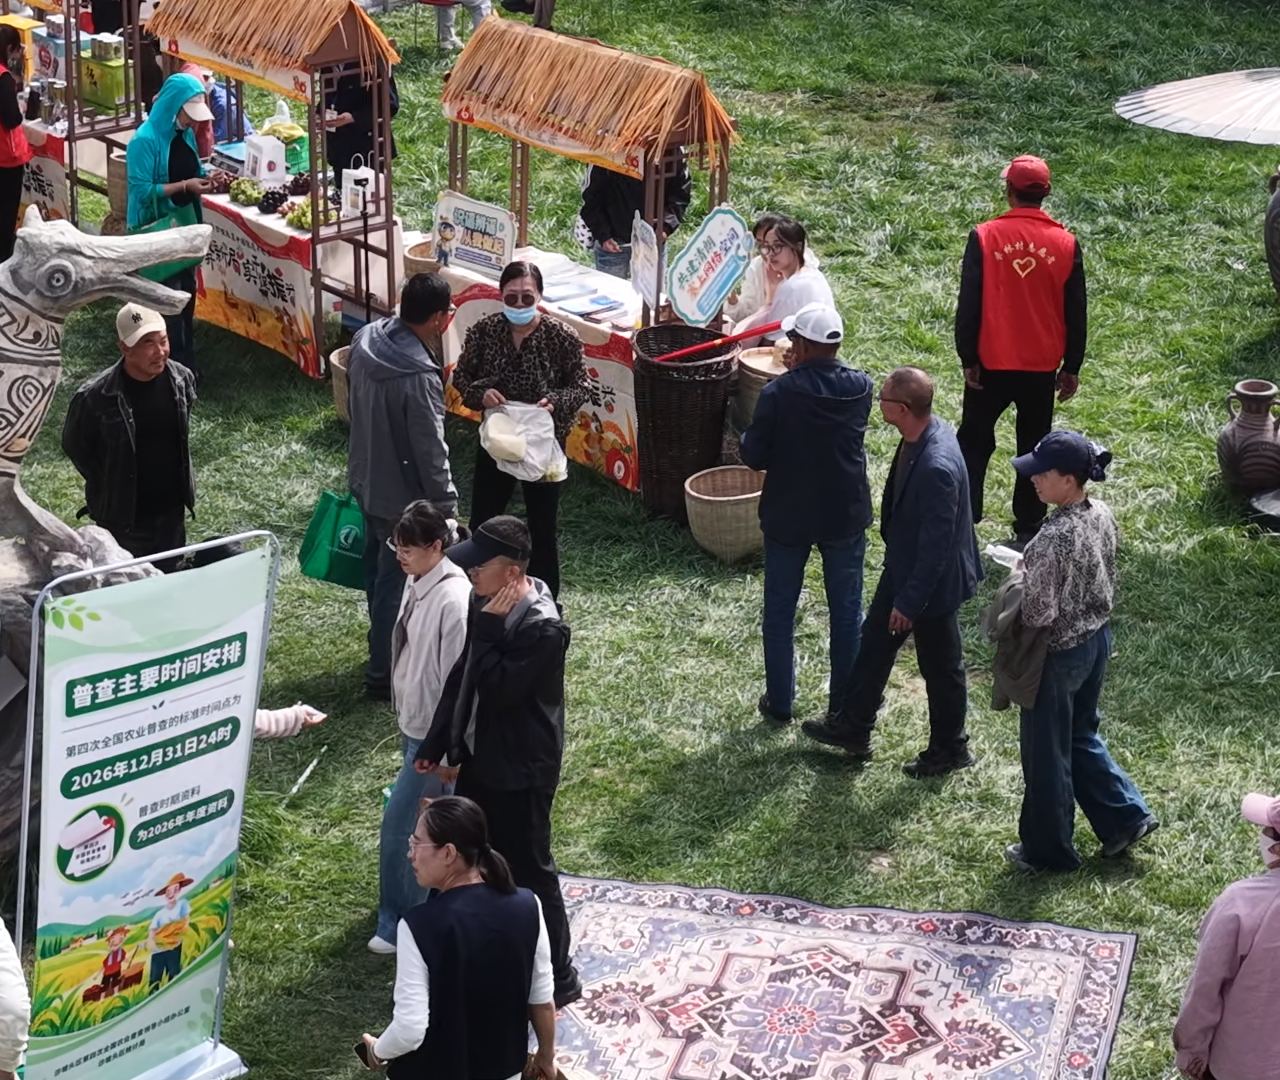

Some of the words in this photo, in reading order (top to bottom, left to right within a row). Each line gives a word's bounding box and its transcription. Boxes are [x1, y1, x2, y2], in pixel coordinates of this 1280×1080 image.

[72, 641, 242, 709] 普查主要时间安排
[65, 694, 241, 759] 第四次全国农业普查的标准时间点为
[70, 722, 233, 792] 2026年12月31日24时
[137, 796, 229, 842] 为2026年年度资料
[138, 785, 202, 818] 普查时期资料
